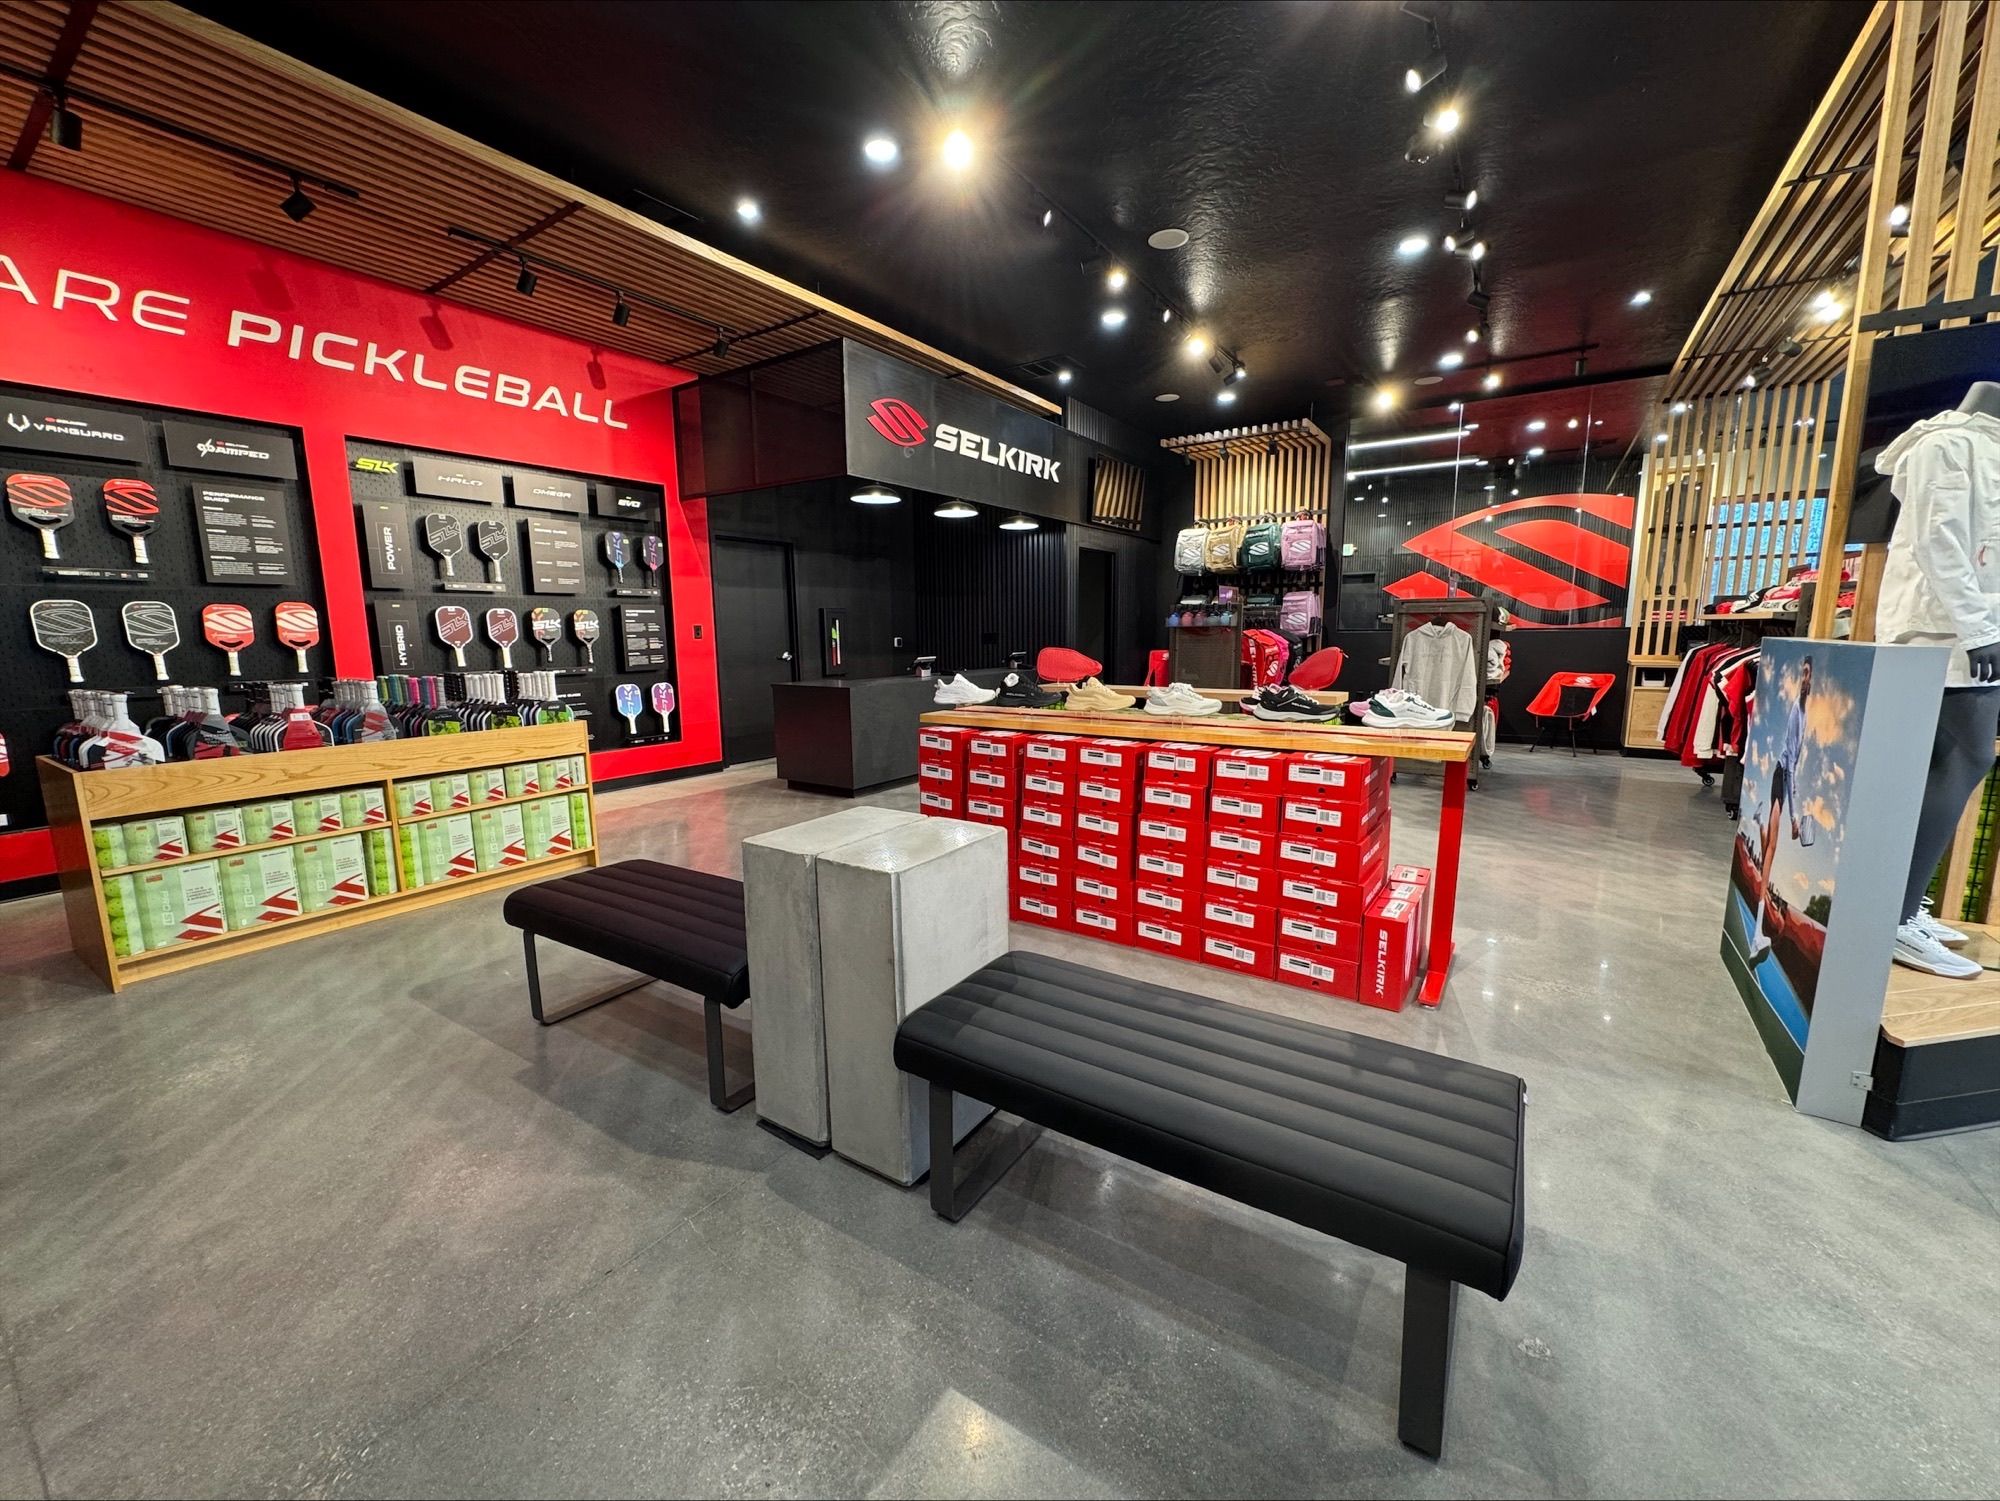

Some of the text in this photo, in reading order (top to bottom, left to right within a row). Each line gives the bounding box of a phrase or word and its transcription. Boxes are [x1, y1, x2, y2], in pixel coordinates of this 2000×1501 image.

[227, 310, 629, 430] PICKLEBALL
[33, 423, 125, 441] VANGUARD
[215, 446, 270, 460] AMPED
[933, 423, 1062, 483] SELKIRK
[355, 457, 399, 474] SLK
[438, 475, 483, 486] HALO
[532, 488, 572, 499] OMEGA
[617, 499, 642, 509] EVO
[429, 521, 461, 547] SLK
[383, 526, 396, 571] POWER
[439, 612, 469, 639] SLK
[532, 618, 562, 630] SLK
[574, 619, 600, 630] SLK
[395, 624, 408, 666] HYBRID
[1375, 928, 1389, 999] SELKIRK
